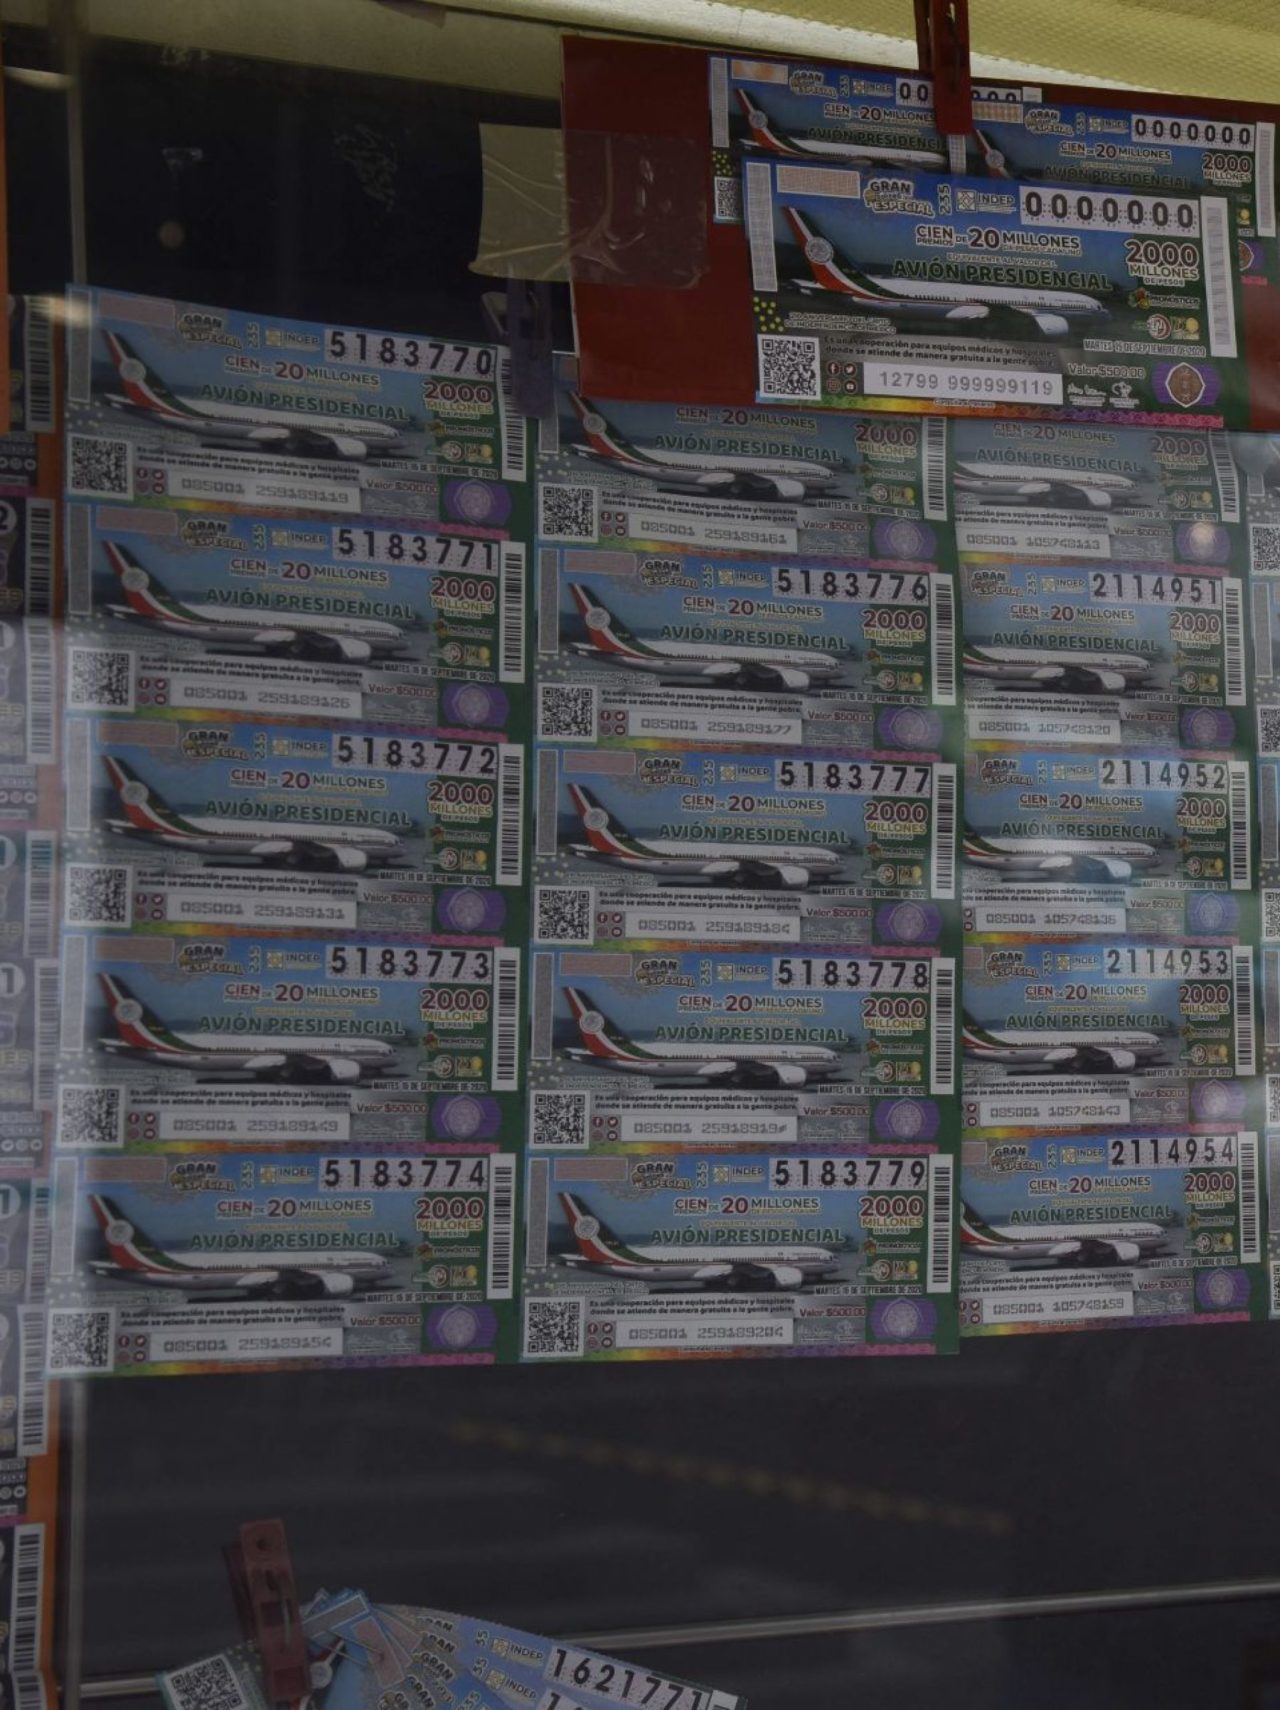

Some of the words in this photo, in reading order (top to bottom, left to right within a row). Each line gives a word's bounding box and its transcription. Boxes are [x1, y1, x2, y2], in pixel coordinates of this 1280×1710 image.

[825, 103, 849, 112] CIEN
[861, 106, 881, 120] 20
[1135, 118, 1250, 146] 0000000
[1061, 142, 1085, 152] CIEN
[1096, 143, 1116, 158] 20
[1119, 147, 1171, 160] MILLONES
[1202, 154, 1251, 172] 2000
[871, 181, 911, 193] GRAN
[979, 192, 1015, 205] INDEP
[875, 202, 933, 217] ESPECIAL
[1025, 191, 1194, 229] 0000000
[916, 225, 953, 239] CIEN
[968, 227, 1000, 249] 20
[1003, 231, 1080, 249] MILLONES
[1126, 240, 1198, 267] 2000
[894, 257, 960, 280] AVIÓN
[967, 264, 1111, 290] PRESIDENCIAL
[1129, 264, 1198, 280] MILLONES
[329, 333, 493, 375] 5183770
[424, 380, 494, 405] 2000
[880, 371, 938, 389] 12799
[948, 375, 1054, 396] 999999119
[269, 391, 409, 421] PRESIDENCIAL
[339, 528, 497, 570] 5183771
[430, 577, 497, 603] 2000
[778, 568, 924, 602] 5183776
[1092, 574, 1224, 603] 2114951
[277, 591, 414, 620] PRESIDENCIAL
[863, 610, 926, 632] 2000
[1170, 613, 1227, 633] 2000
[660, 621, 717, 641] AVIÓN
[723, 627, 848, 650] PRESIDENCIAL
[1048, 633, 1159, 652] PRESIDENCIAL
[338, 736, 495, 773] 5183772
[780, 762, 928, 793] 5183777
[1104, 762, 1228, 790] 2114952
[428, 783, 495, 806] 2000
[205, 796, 268, 817] AVIÓN
[275, 802, 411, 826] PRESIDENCIAL
[865, 803, 928, 823] 2000
[1175, 799, 1228, 818] 2000
[659, 820, 716, 839] AVIÓN
[723, 824, 849, 845] PRESIDENCIAL
[1057, 821, 1164, 839] PRESIDENCIAL
[331, 948, 489, 979] 5183773
[778, 960, 928, 988] 5183778
[1107, 950, 1230, 975] 2114953
[422, 990, 488, 1011] 2000
[1178, 987, 1230, 1004] 2000
[863, 999, 927, 1019] 2000
[1062, 1013, 1168, 1027] PRESIDENCIAL
[268, 1015, 404, 1035] PRESIDENCIAL
[655, 1022, 713, 1040] AVIÓN
[719, 1024, 847, 1042] PRESIDENCIAL
[1112, 1140, 1235, 1165] 2114954
[325, 1161, 484, 1187] 5183774
[775, 1161, 925, 1186] 5183779
[1183, 1174, 1236, 1192] 2000
[416, 1200, 484, 1219] 2000
[675, 1199, 708, 1210] CIEN
[722, 1198, 748, 1213] 20
[752, 1198, 819, 1209] MILLONES
[860, 1198, 924, 1216] 2000
[1066, 1203, 1173, 1220] PRESIDENCIAL
[191, 1230, 254, 1248] AVIÓN
[260, 1230, 398, 1247] PRESIDENCIAL
[651, 1226, 709, 1242] AVIÓN
[716, 1227, 844, 1242] PRESIDENCIAL
